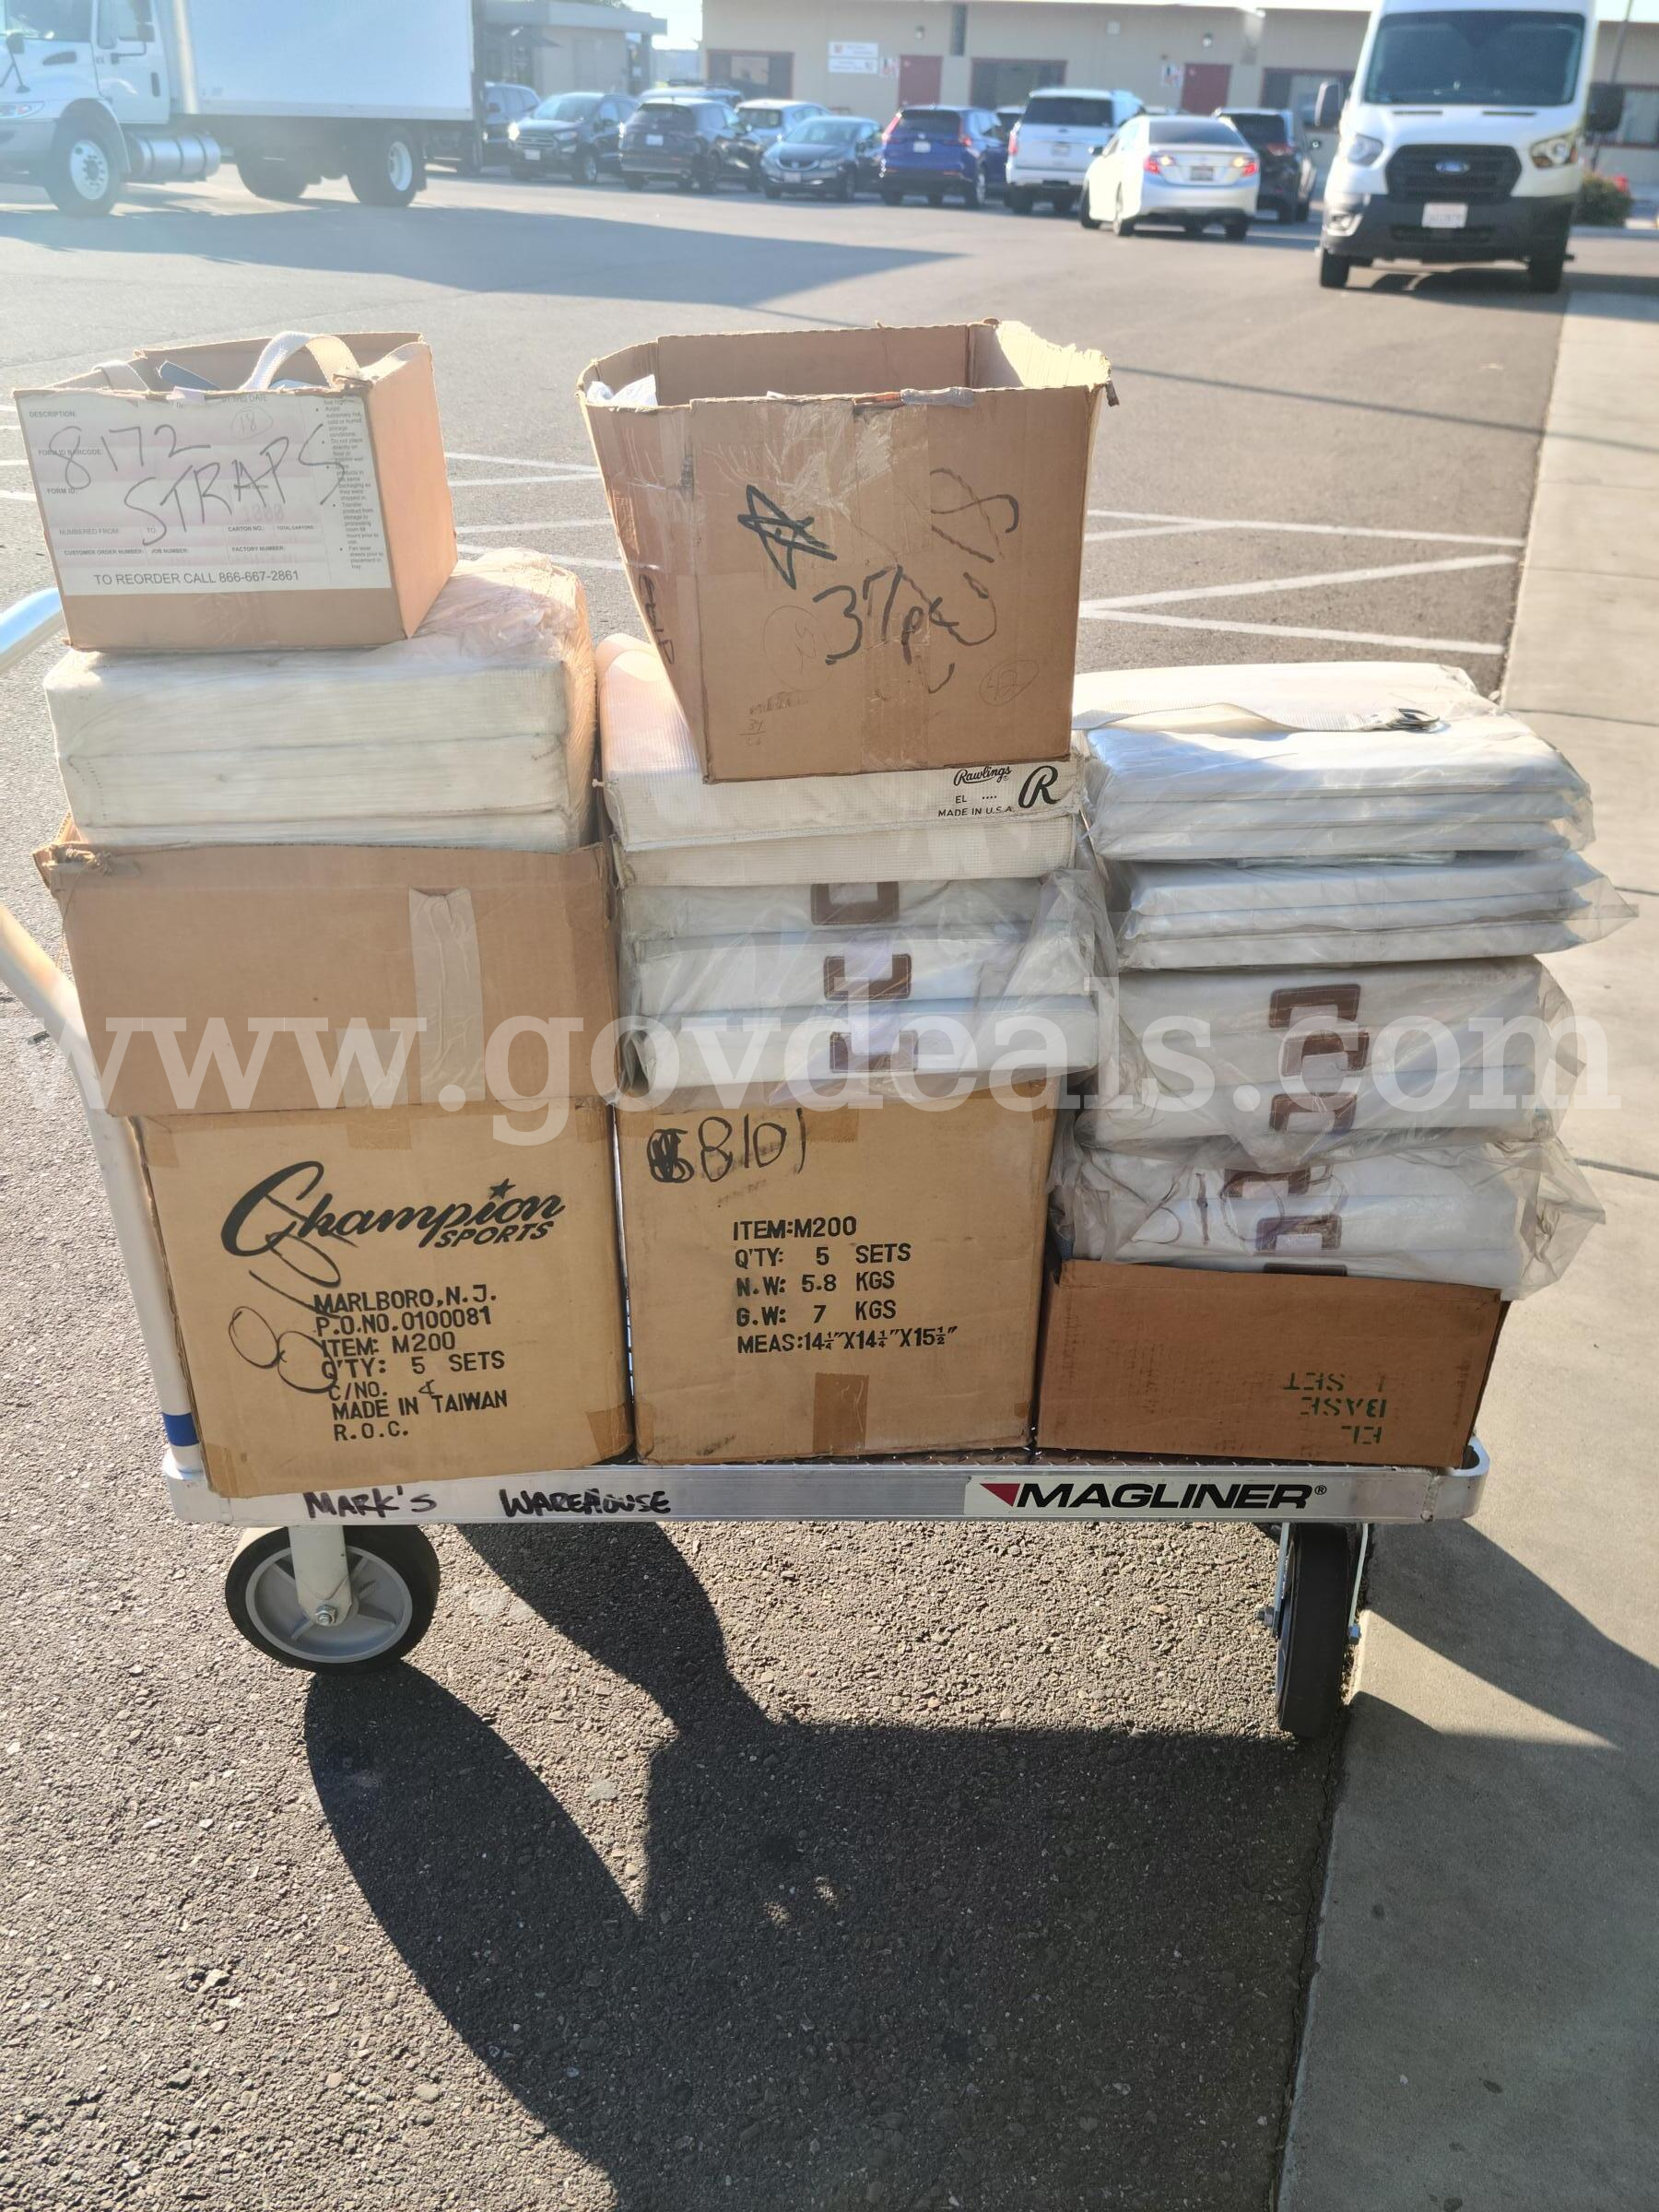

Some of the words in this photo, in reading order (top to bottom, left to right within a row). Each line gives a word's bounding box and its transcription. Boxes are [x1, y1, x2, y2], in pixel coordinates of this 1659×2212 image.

[47, 425, 212, 490] 8172
[124, 422, 347, 546] STRAPS
[94, 574, 112, 585] TO
[116, 573, 181, 584] REORDER
[183, 571, 217, 583] CALL
[218, 570, 300, 583] 866-667-2861
[953, 766, 1012, 786] Rawlings
[1018, 765, 1062, 809] R
[938, 807, 969, 817] MADE
[971, 806, 982, 816] IN
[955, 794, 969, 804] EL
[220, 1160, 566, 1257] Champion
[434, 1220, 555, 1249] SPORTS
[735, 1246, 784, 1270] Q'TY:
[816, 1246, 830, 1266] 5
[855, 1242, 912, 1265] SETS
[736, 1276, 786, 1297] N.W:
[801, 1274, 837, 1293] 5.8
[855, 1270, 896, 1291] KGS
[736, 1305, 787, 1327] G.W:
[812, 1304, 827, 1324] 7
[854, 1299, 897, 1321] KGS
[322, 1336, 379, 1359] ITEM:
[392, 1331, 455, 1354] M200
[321, 1357, 386, 1380] Q'TY:
[411, 1356, 426, 1375] 5
[448, 1349, 506, 1372] SETS
[328, 1381, 388, 1401] C/NO.
[332, 1398, 390, 1420] MADE
[398, 1396, 419, 1417] IN
[430, 1389, 508, 1413] TAIWAN
[334, 1420, 409, 1441] R.O.C.
[499, 1487, 671, 1518] WAREHOUSE
[1017, 1482, 1314, 1510] MAGLINER
